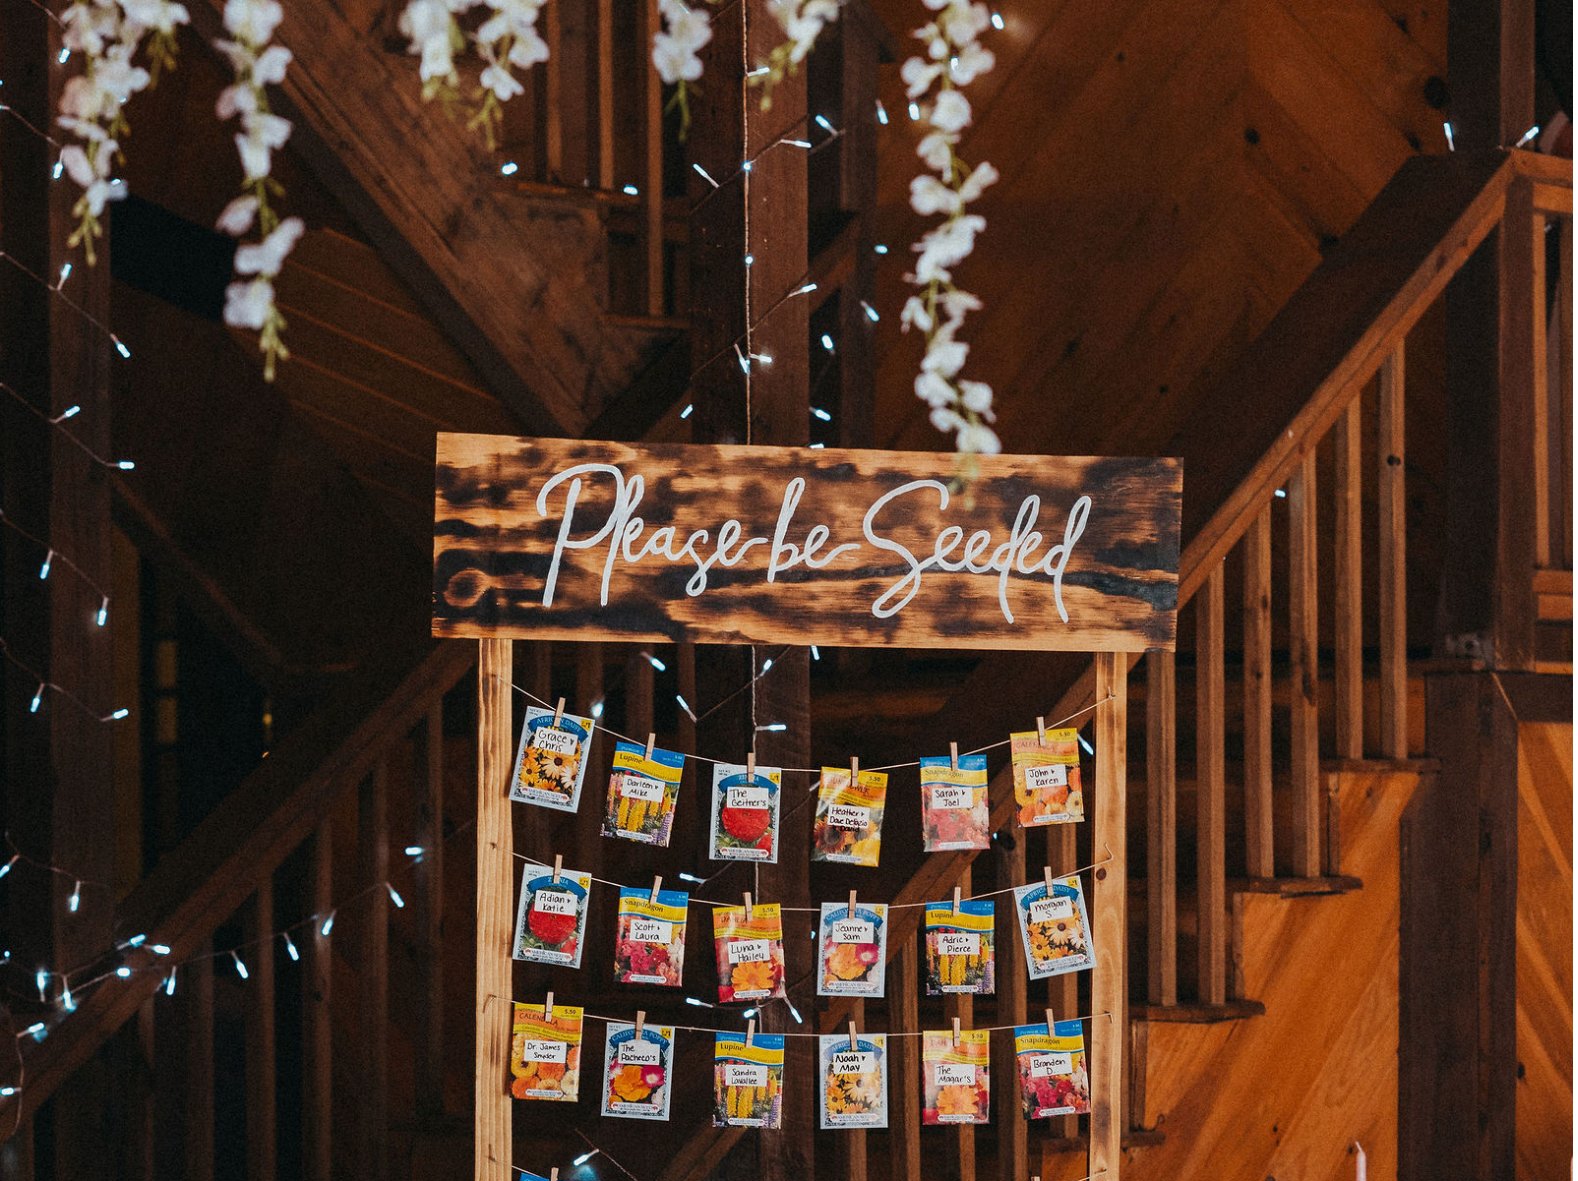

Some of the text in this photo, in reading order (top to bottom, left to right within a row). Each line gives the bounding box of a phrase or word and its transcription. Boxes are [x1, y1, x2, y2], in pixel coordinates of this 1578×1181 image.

[536, 463, 1092, 625] Please be Seeded
[538, 730, 567, 744] Grace
[538, 740, 562, 752] Chris
[1029, 769, 1048, 778] John
[1036, 777, 1060, 786] Karen
[628, 788, 648, 798] Mike
[730, 788, 748, 798] The
[934, 790, 959, 798] Sarah
[944, 798, 960, 807] Joel
[832, 807, 860, 816] Heather
[542, 904, 564, 912] Katie
[634, 922, 656, 931] Scott
[635, 932, 660, 940] Laura
[731, 944, 754, 954] Luna
[946, 944, 972, 954] Pierce
[738, 952, 764, 962] Hailey
[540, 1042, 560, 1051] James
[622, 1044, 635, 1052] The
[720, 1042, 744, 1052] Lupine
[835, 1054, 860, 1062] Noah
[732, 1068, 757, 1076] Sandra
[840, 1064, 860, 1072] May
[936, 1065, 952, 1074] The
